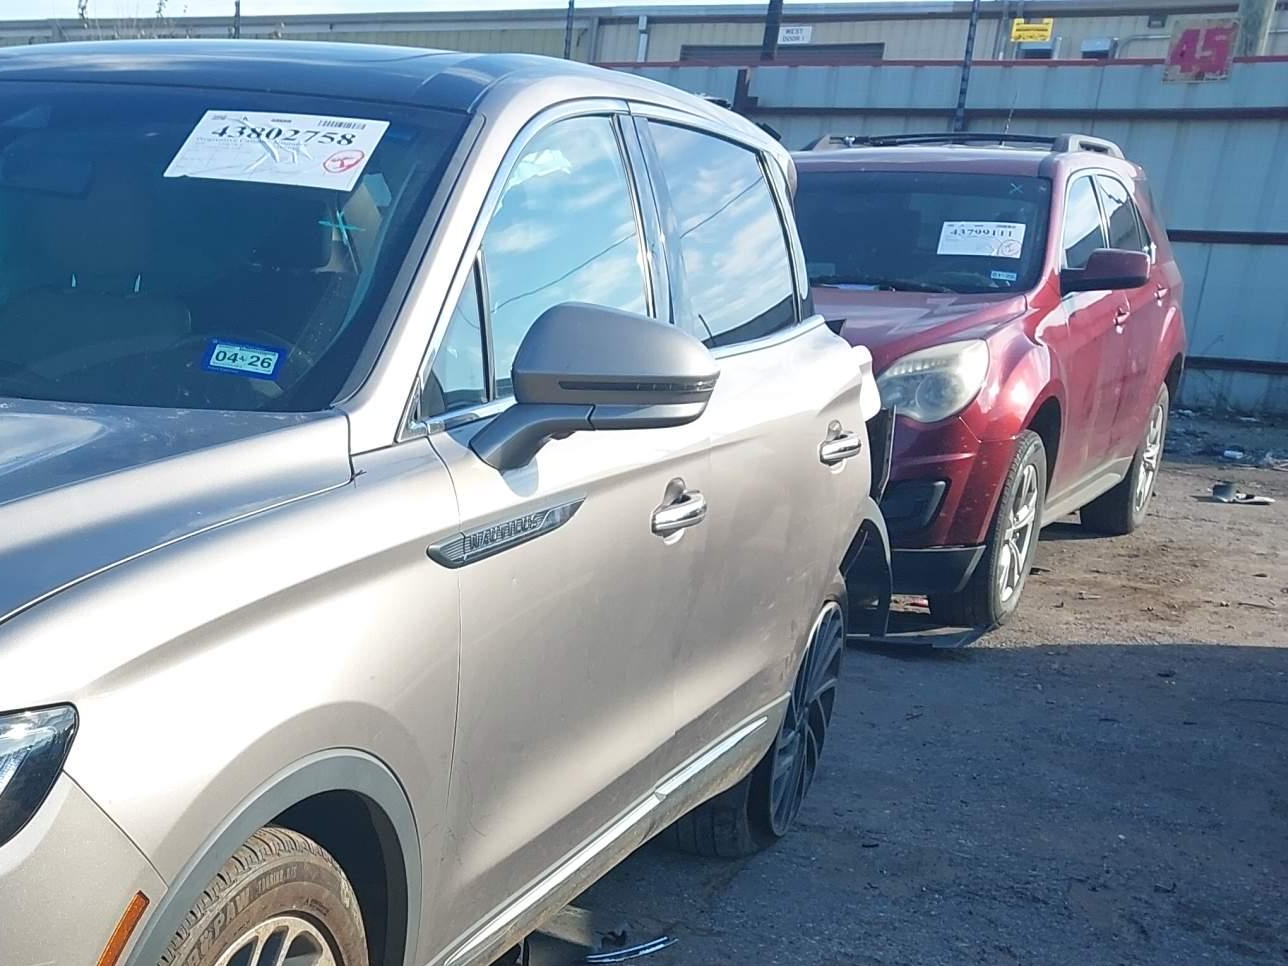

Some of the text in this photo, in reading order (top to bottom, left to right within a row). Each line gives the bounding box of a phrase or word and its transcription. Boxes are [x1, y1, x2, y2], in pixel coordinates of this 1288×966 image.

[1169, 26, 1233, 74] 45
[212, 125, 356, 146] 43802758
[950, 228, 1013, 237] 43799111
[215, 350, 273, 369] 04 26
[469, 513, 544, 550] NAUTILUS
[213, 886, 250, 938] PAW
